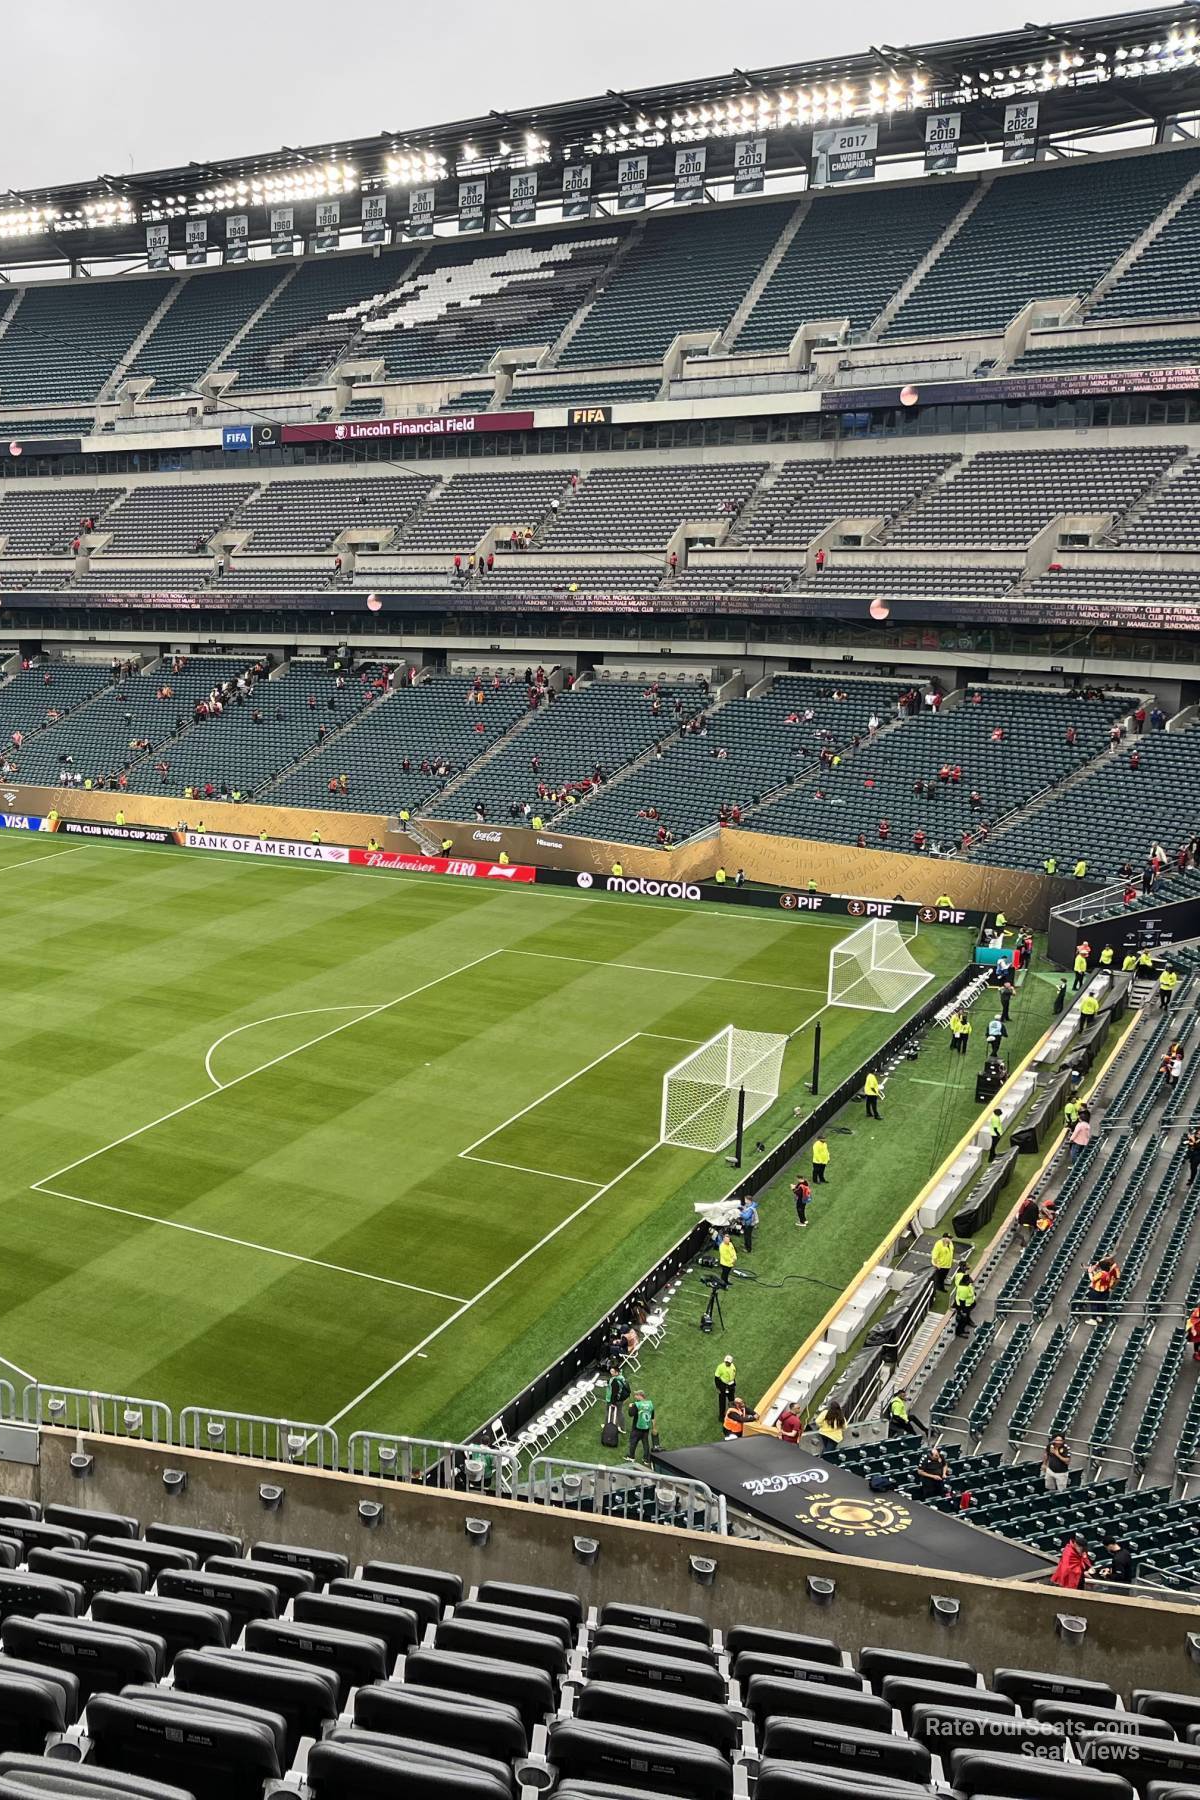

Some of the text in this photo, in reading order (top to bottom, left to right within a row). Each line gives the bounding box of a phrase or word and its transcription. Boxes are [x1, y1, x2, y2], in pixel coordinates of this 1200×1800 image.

[1007, 117, 1034, 131] 2022
[930, 128, 955, 141] 2019
[840, 135, 867, 148] 2017
[738, 153, 762, 165] 2013
[840, 152, 865, 163] WORLD
[679, 162, 701, 174] 2010
[831, 159, 873, 171] CHAMPIONS
[621, 170, 644, 181] 2006
[565, 178, 588, 189] 2004
[513, 186, 534, 198] 2003
[461, 194, 482, 206] 2002
[412, 202, 432, 212] 2001
[229, 227, 246, 237] 1949
[149, 236, 167, 246] 1947
[573, 409, 605, 424] FIFA
[350, 417, 475, 437] Lincoln Financial Field
[226, 432, 247, 443] FIFA
[3, 814, 30, 829] VISA
[66, 823, 83, 833] FIFA
[83, 825, 101, 835] CLUB
[102, 827, 129, 838] WORLD
[130, 830, 144, 839] CUP
[472, 829, 502, 843] Coca-Cola
[189, 835, 323, 859] BANK OF AMERICA
[536, 838, 563, 849] Hisense
[363, 850, 476, 877] Budweiser ZERO
[606, 876, 701, 902] motorola
[797, 896, 823, 910] PIF
[866, 903, 892, 917] PIF
[938, 910, 965, 924] PIF
[741, 1467, 831, 1498] Coca-Cola
[816, 1523, 856, 1537] CUP
